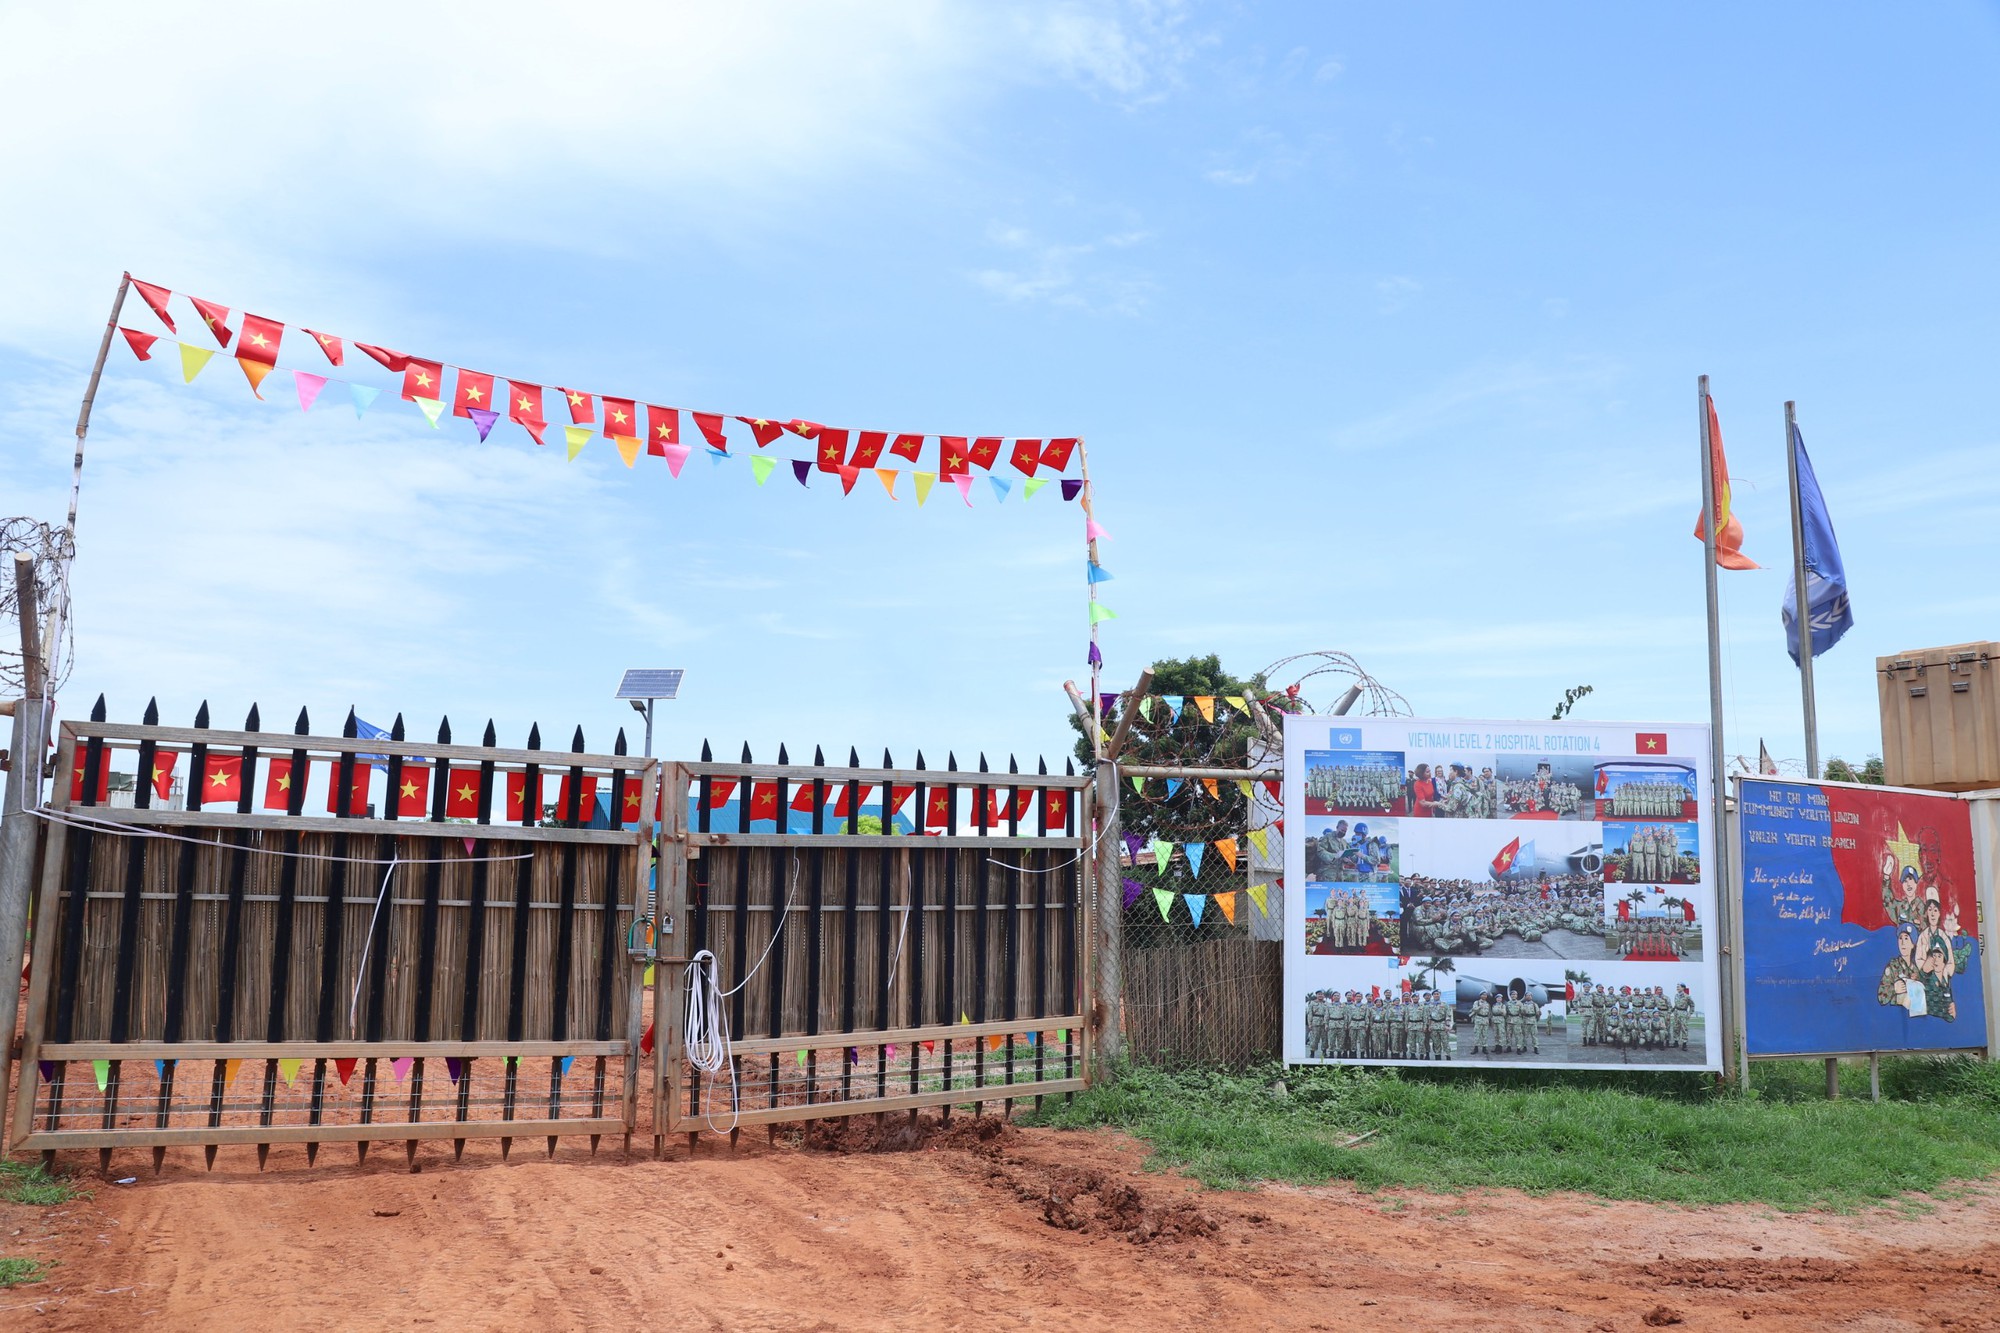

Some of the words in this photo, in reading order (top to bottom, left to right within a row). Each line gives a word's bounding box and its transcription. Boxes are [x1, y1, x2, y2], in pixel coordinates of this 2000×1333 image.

[1408, 732, 1451, 748] VIETNAM
[1453, 733, 1482, 749] LEVEL
[1485, 734, 1492, 749] 2
[1494, 734, 1541, 750] HOSPITAL
[1544, 735, 1590, 751] ROTATION
[1593, 736, 1600, 751] 4
[1769, 790, 1782, 802] HO
[1787, 792, 1801, 804] CHI
[1807, 793, 1830, 806] MINH
[1798, 808, 1831, 821] YOUTH
[1834, 811, 1860, 824] UNION
[1784, 832, 1816, 847] YOUTH
